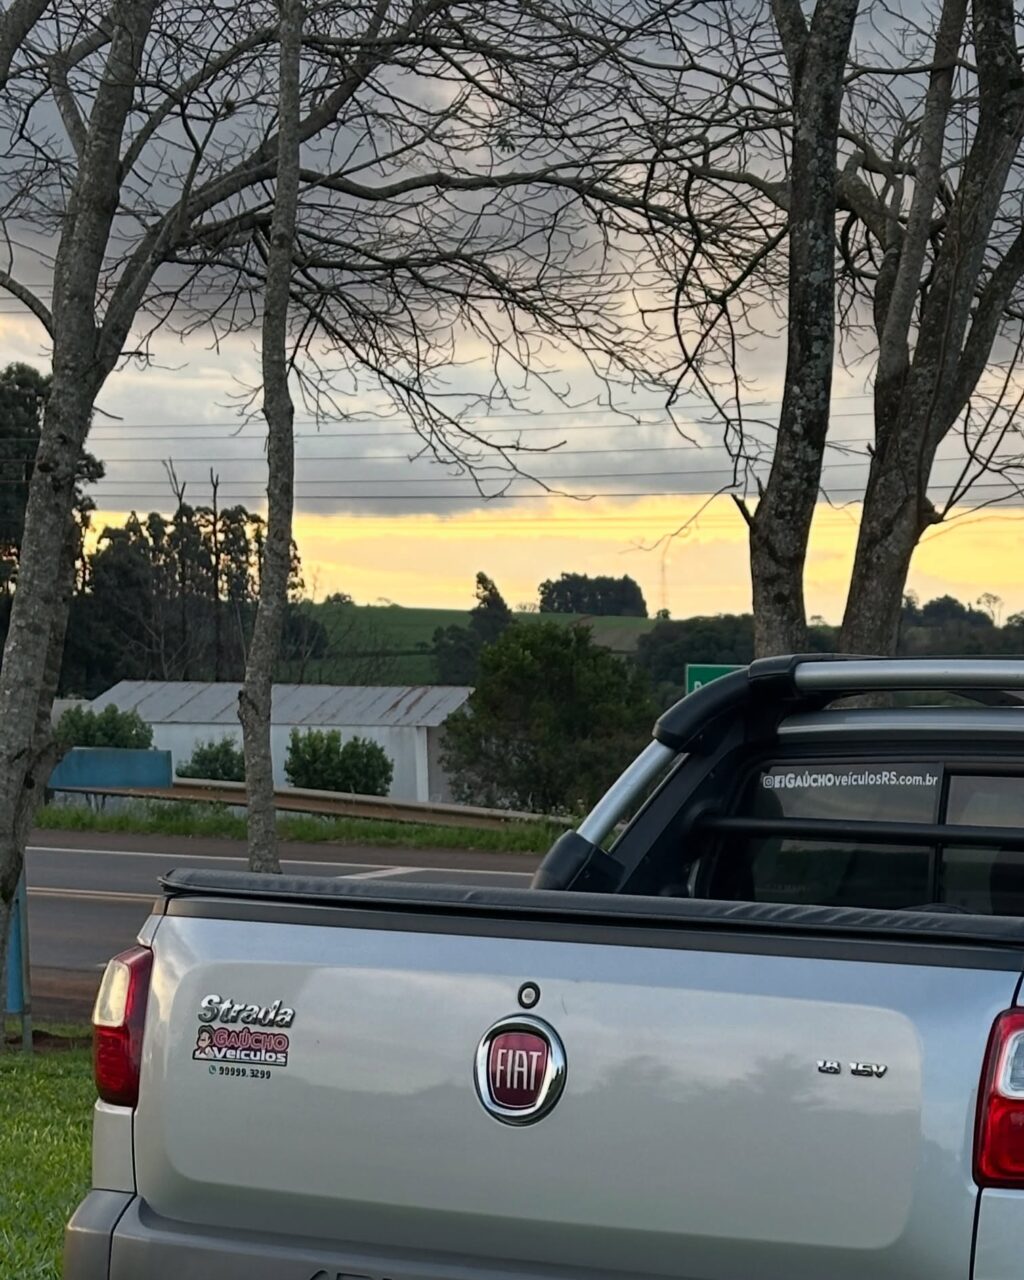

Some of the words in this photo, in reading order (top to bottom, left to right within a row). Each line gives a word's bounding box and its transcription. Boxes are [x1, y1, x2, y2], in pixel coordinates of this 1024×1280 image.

[198, 994, 295, 1028] Strada
[214, 1027, 289, 1052] GAÚCHO
[212, 1047, 287, 1063] Veículos
[496, 1048, 542, 1090] FIAT
